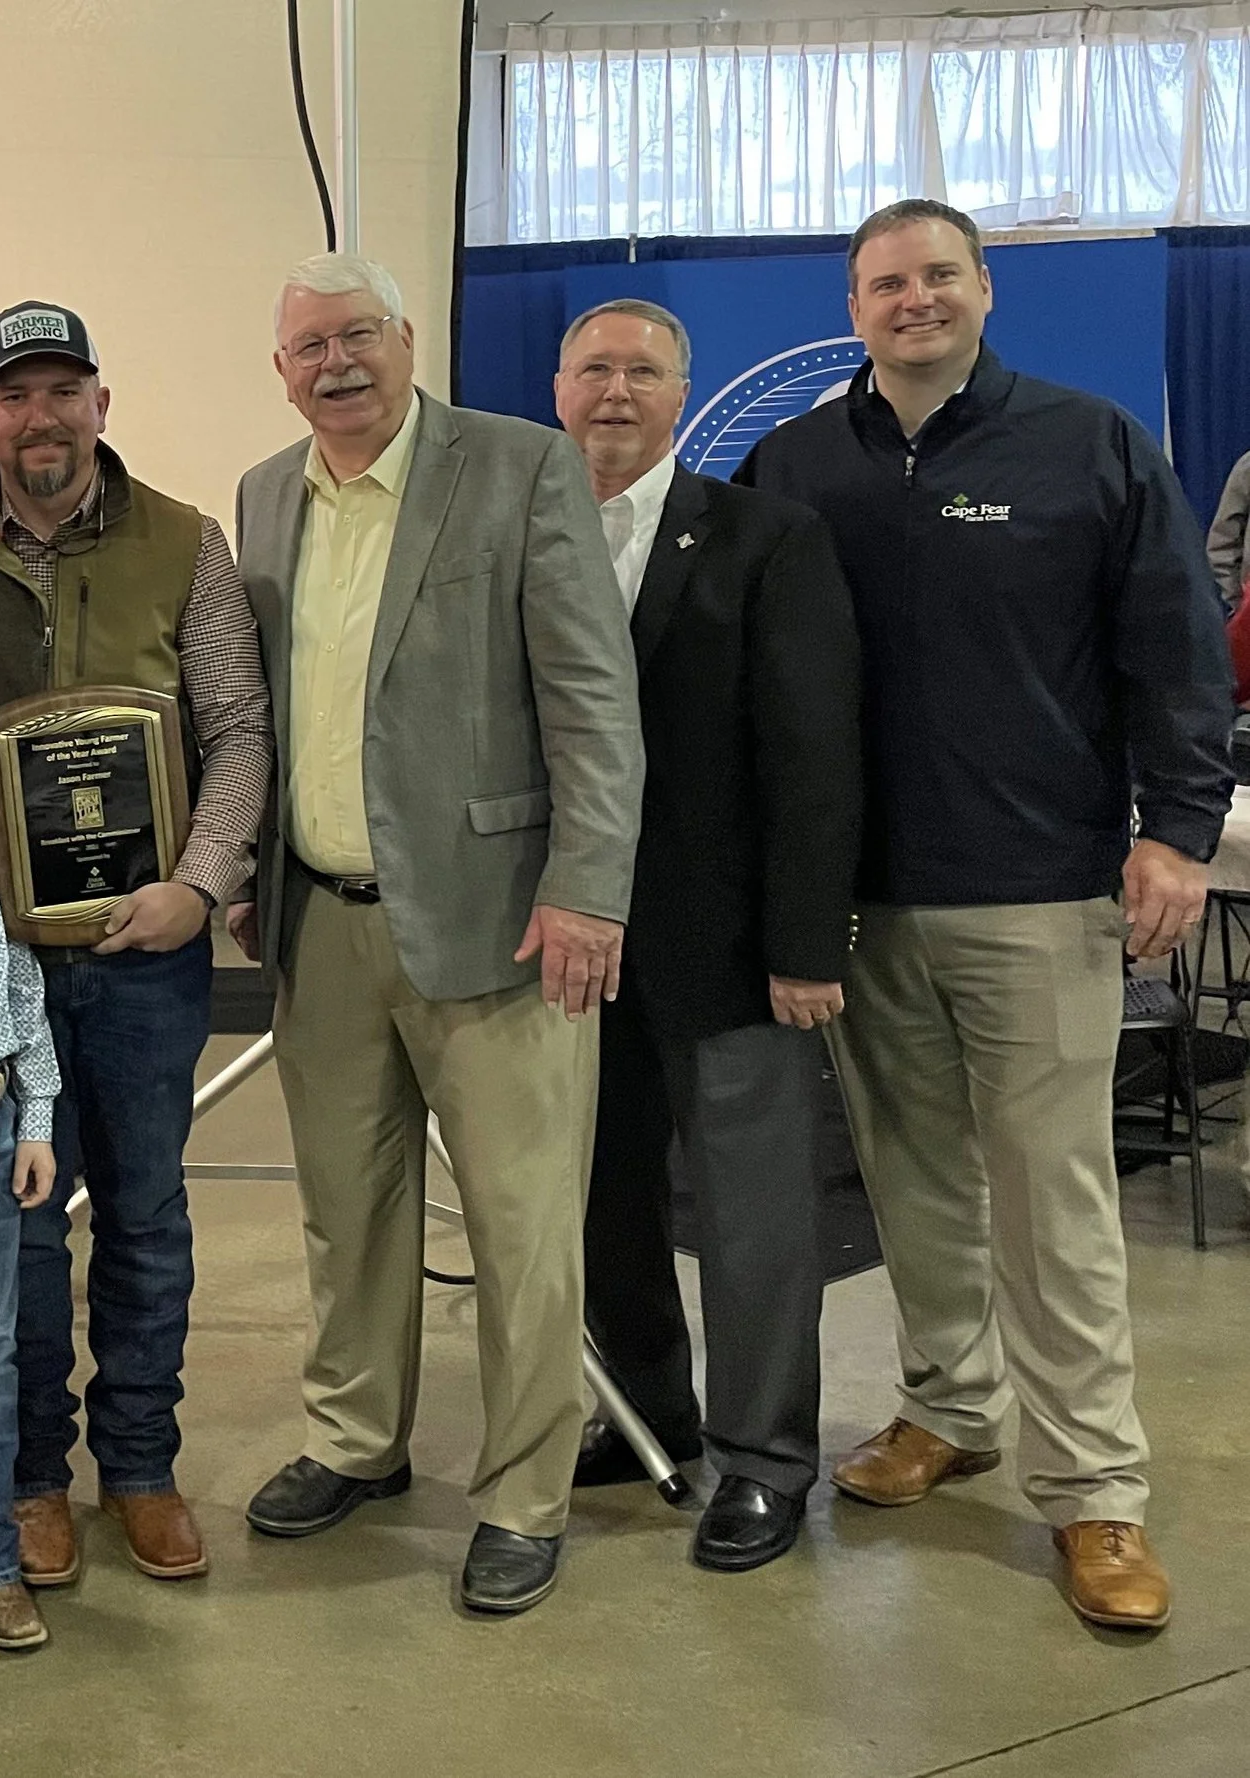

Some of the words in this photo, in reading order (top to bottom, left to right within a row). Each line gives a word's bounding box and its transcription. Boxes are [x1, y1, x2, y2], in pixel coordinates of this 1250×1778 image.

[4, 316, 64, 335] FARMER
[6, 327, 63, 346] STRONG
[941, 506, 977, 518] Cape
[981, 504, 1011, 515] Fear
[46, 753, 56, 762] of
[56, 752, 71, 761] the
[91, 745, 117, 756] Award
